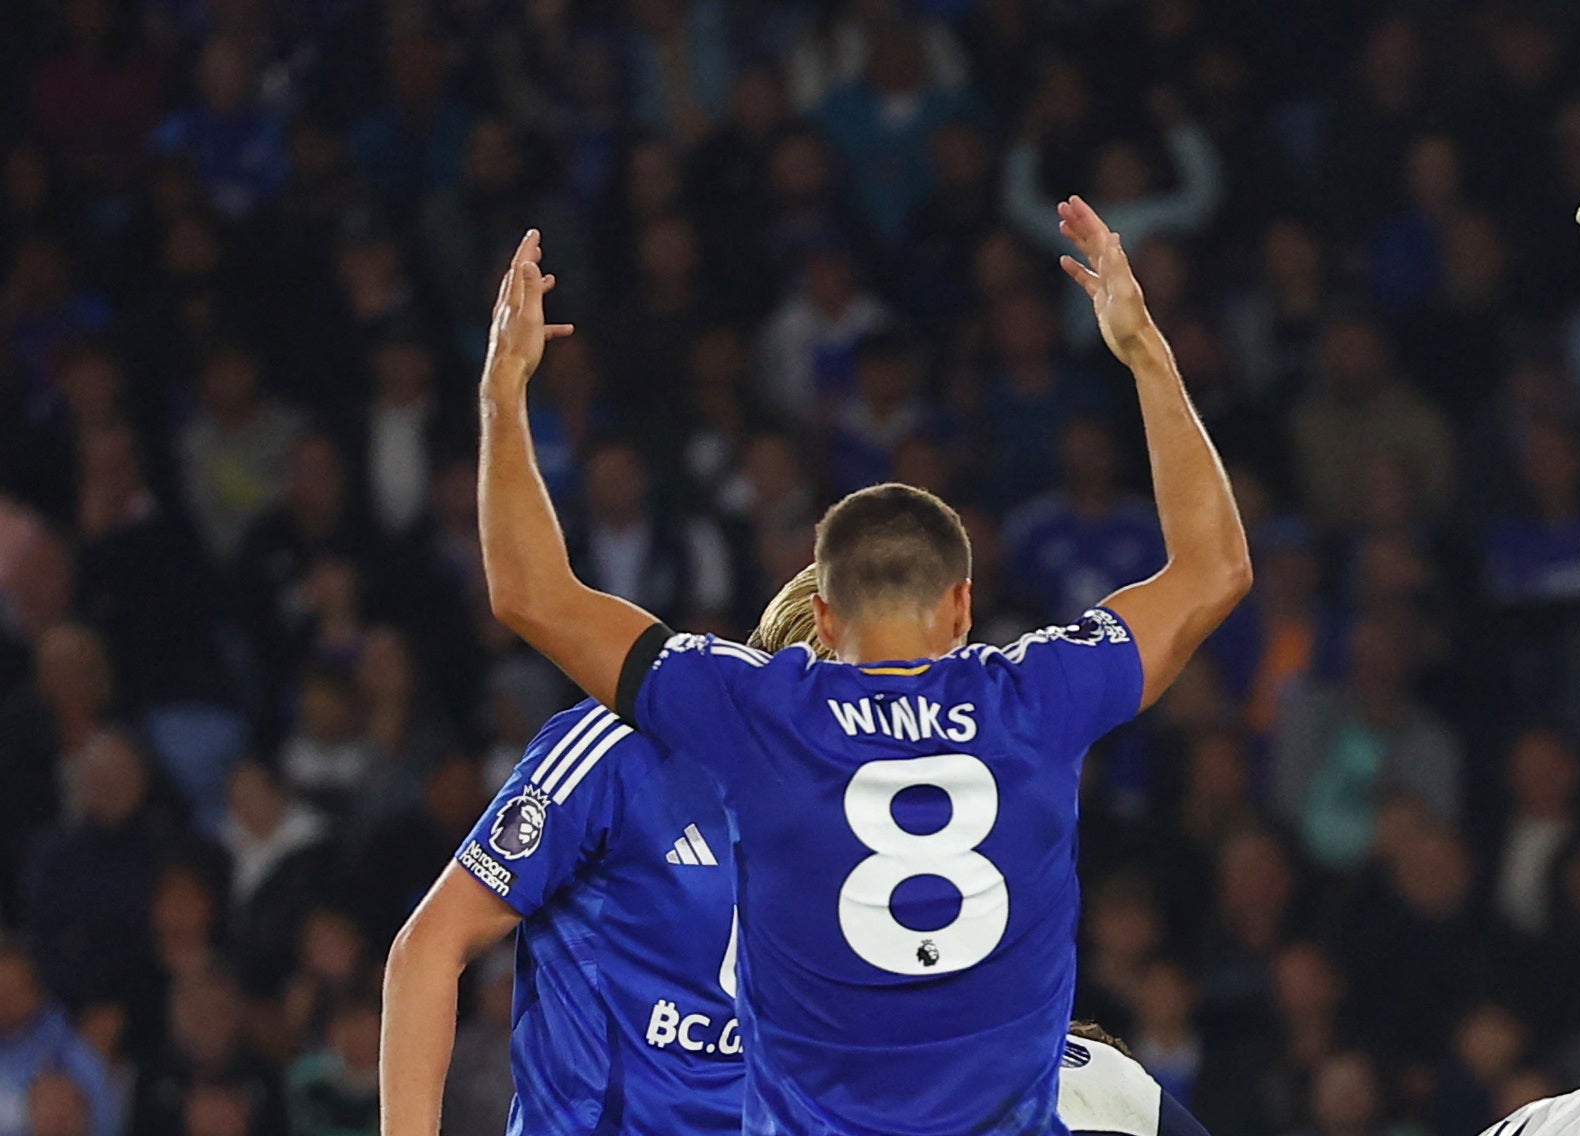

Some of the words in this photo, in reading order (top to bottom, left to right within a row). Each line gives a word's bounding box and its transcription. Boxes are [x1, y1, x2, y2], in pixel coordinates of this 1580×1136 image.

[464, 839, 483, 859] No
[478, 853, 512, 884] room
[470, 861, 511, 897] racism
[838, 753, 1010, 977] 8
[645, 998, 744, 1055] BC.G
